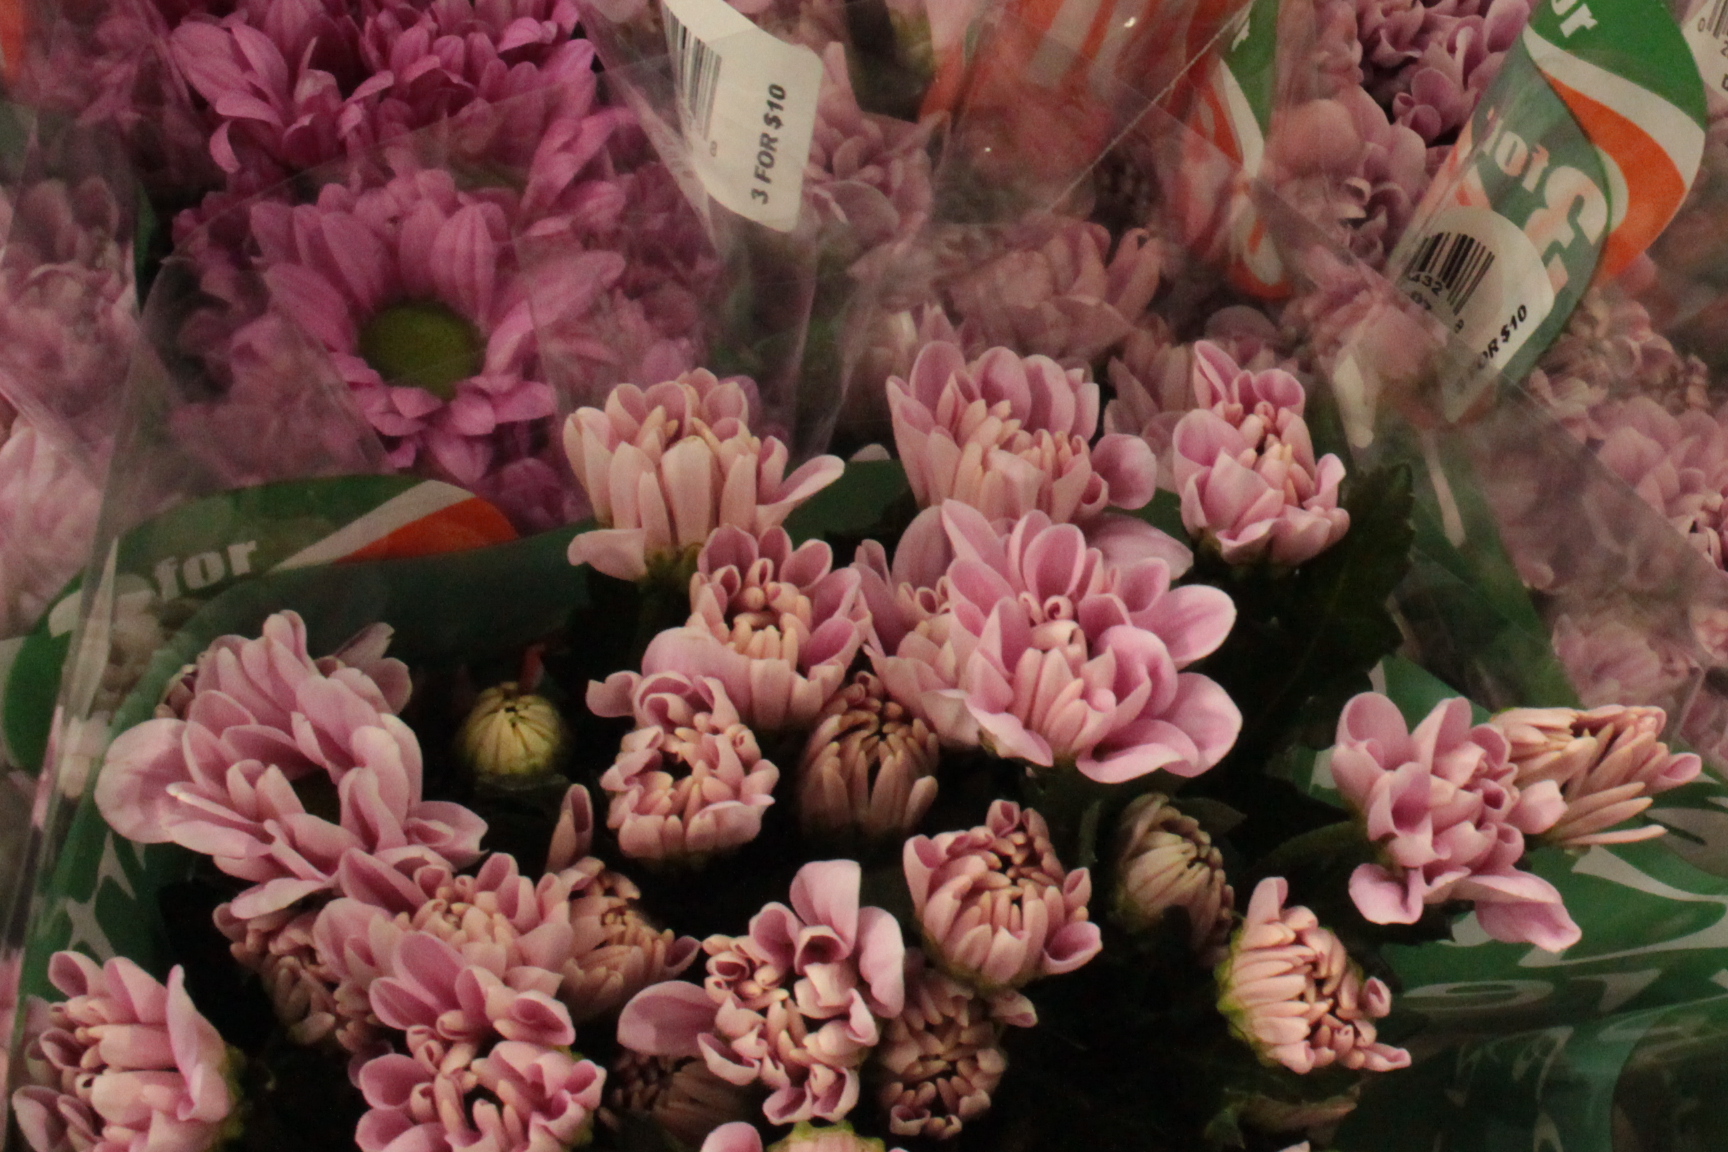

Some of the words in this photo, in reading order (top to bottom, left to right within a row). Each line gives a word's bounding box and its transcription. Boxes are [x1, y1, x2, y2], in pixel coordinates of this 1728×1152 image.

[764, 84, 787, 131] $10
[754, 132, 778, 186] FOR
[752, 188, 769, 205] 3
[1500, 304, 1528, 344] $10
[155, 540, 257, 599] for
